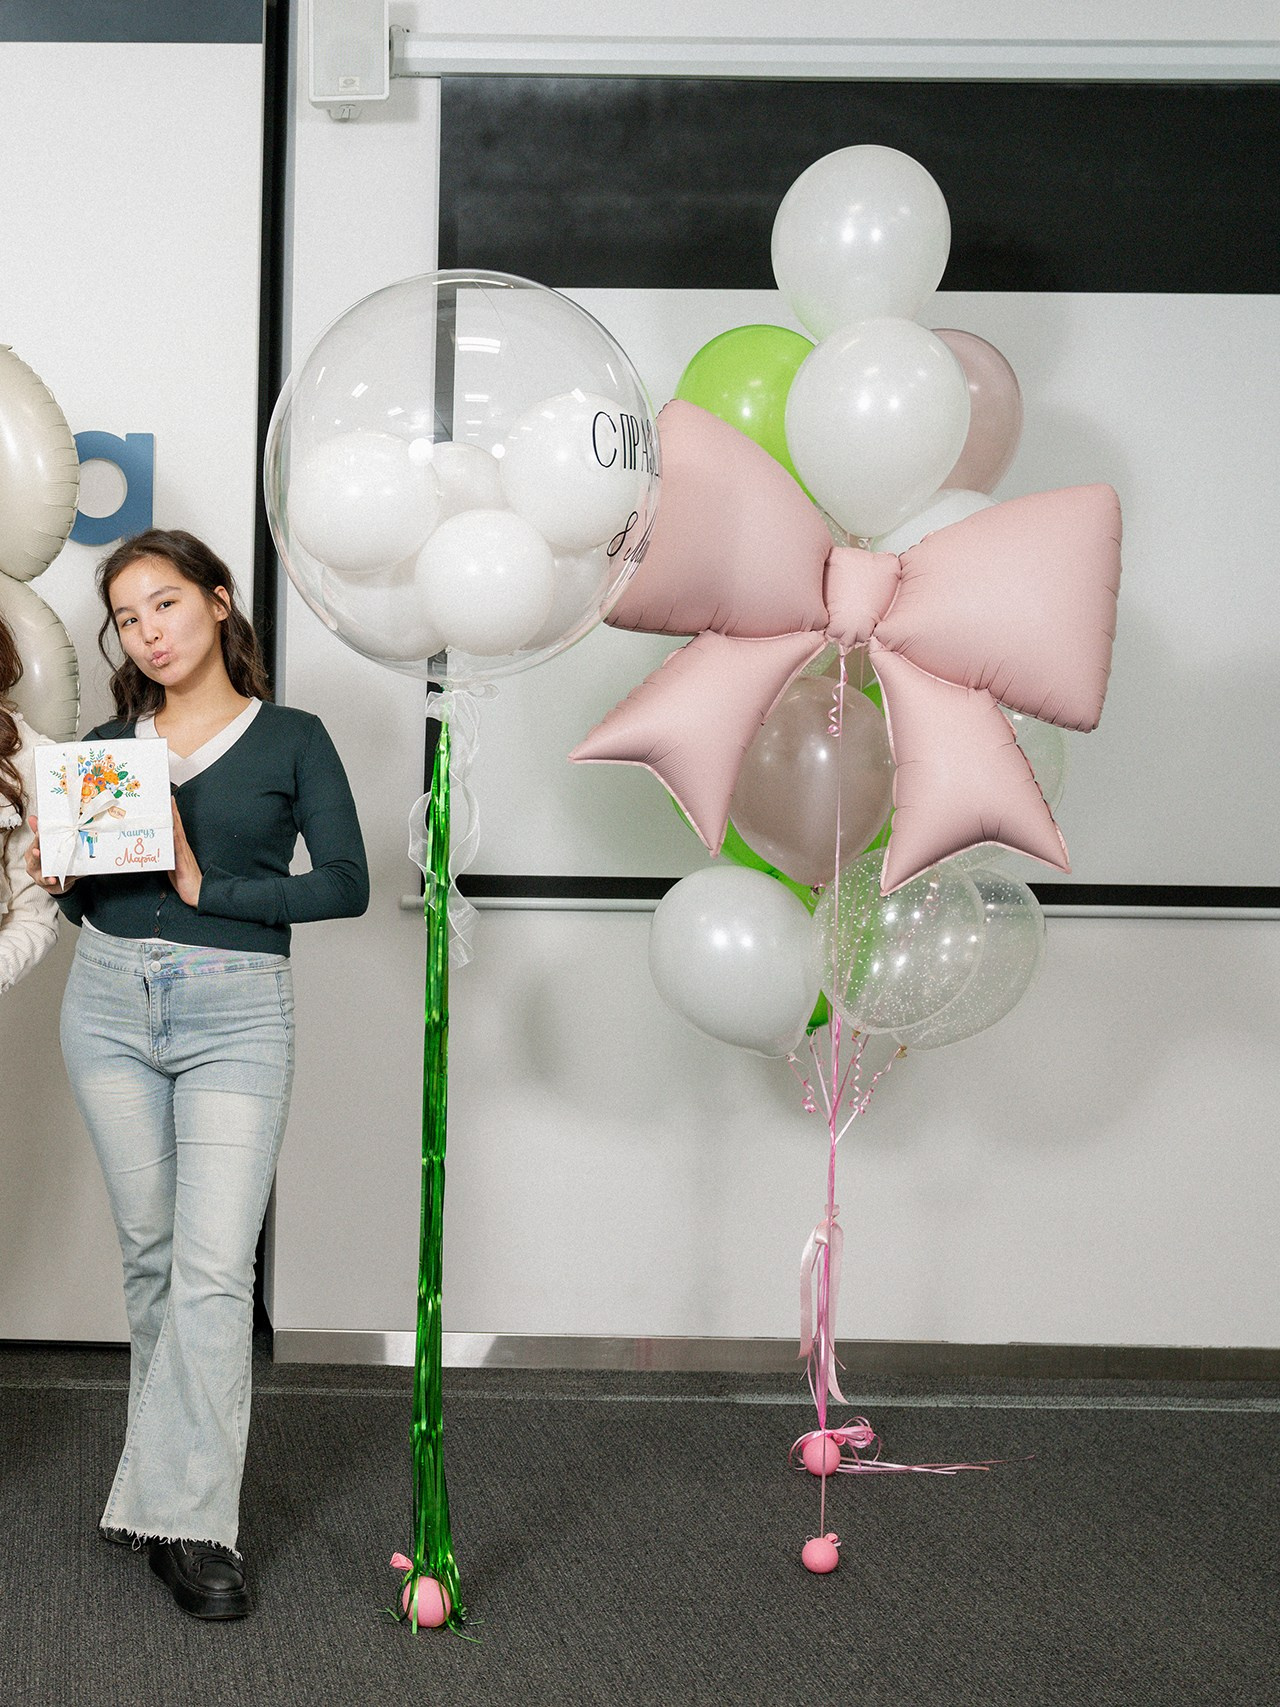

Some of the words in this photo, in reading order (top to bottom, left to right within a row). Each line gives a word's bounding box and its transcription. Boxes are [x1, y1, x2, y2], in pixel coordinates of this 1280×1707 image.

[592, 411, 618, 468] С
[133, 837, 145, 855] 8
[114, 847, 161, 868] Марта!
